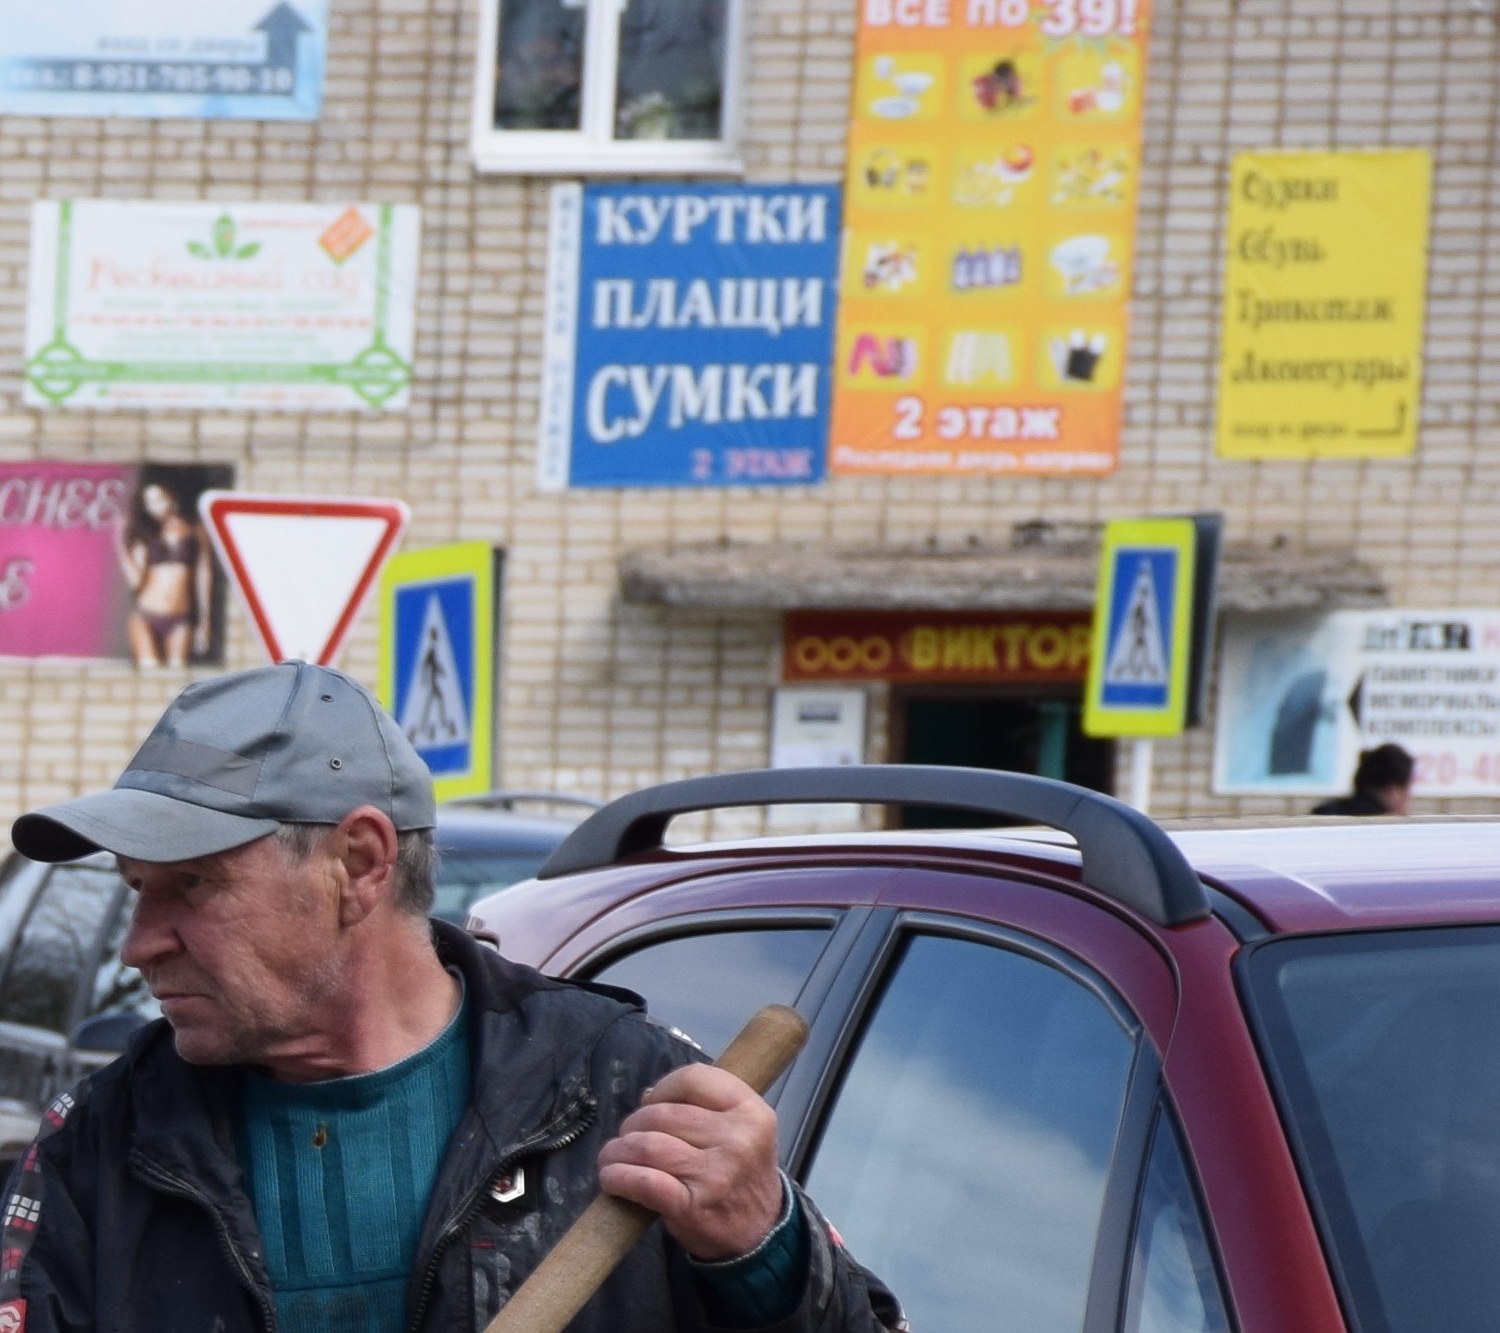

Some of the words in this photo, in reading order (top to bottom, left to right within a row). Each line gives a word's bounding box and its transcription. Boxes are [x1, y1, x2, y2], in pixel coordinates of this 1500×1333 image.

[1242, 171, 1338, 209] Сумки
[596, 195, 827, 244] КУРТКИ
[1239, 226, 1326, 269] Обувь
[593, 277, 823, 337] ПЛАЩИ
[1236, 289, 1393, 331] Трикотаж
[585, 363, 818, 443] СУМКИ
[893, 396, 923, 440] 2
[936, 405, 1059, 440] этаж
[691, 449, 713, 480] 2
[725, 448, 812, 478] ЭТАЖ
[796, 634, 893, 671] ООО
